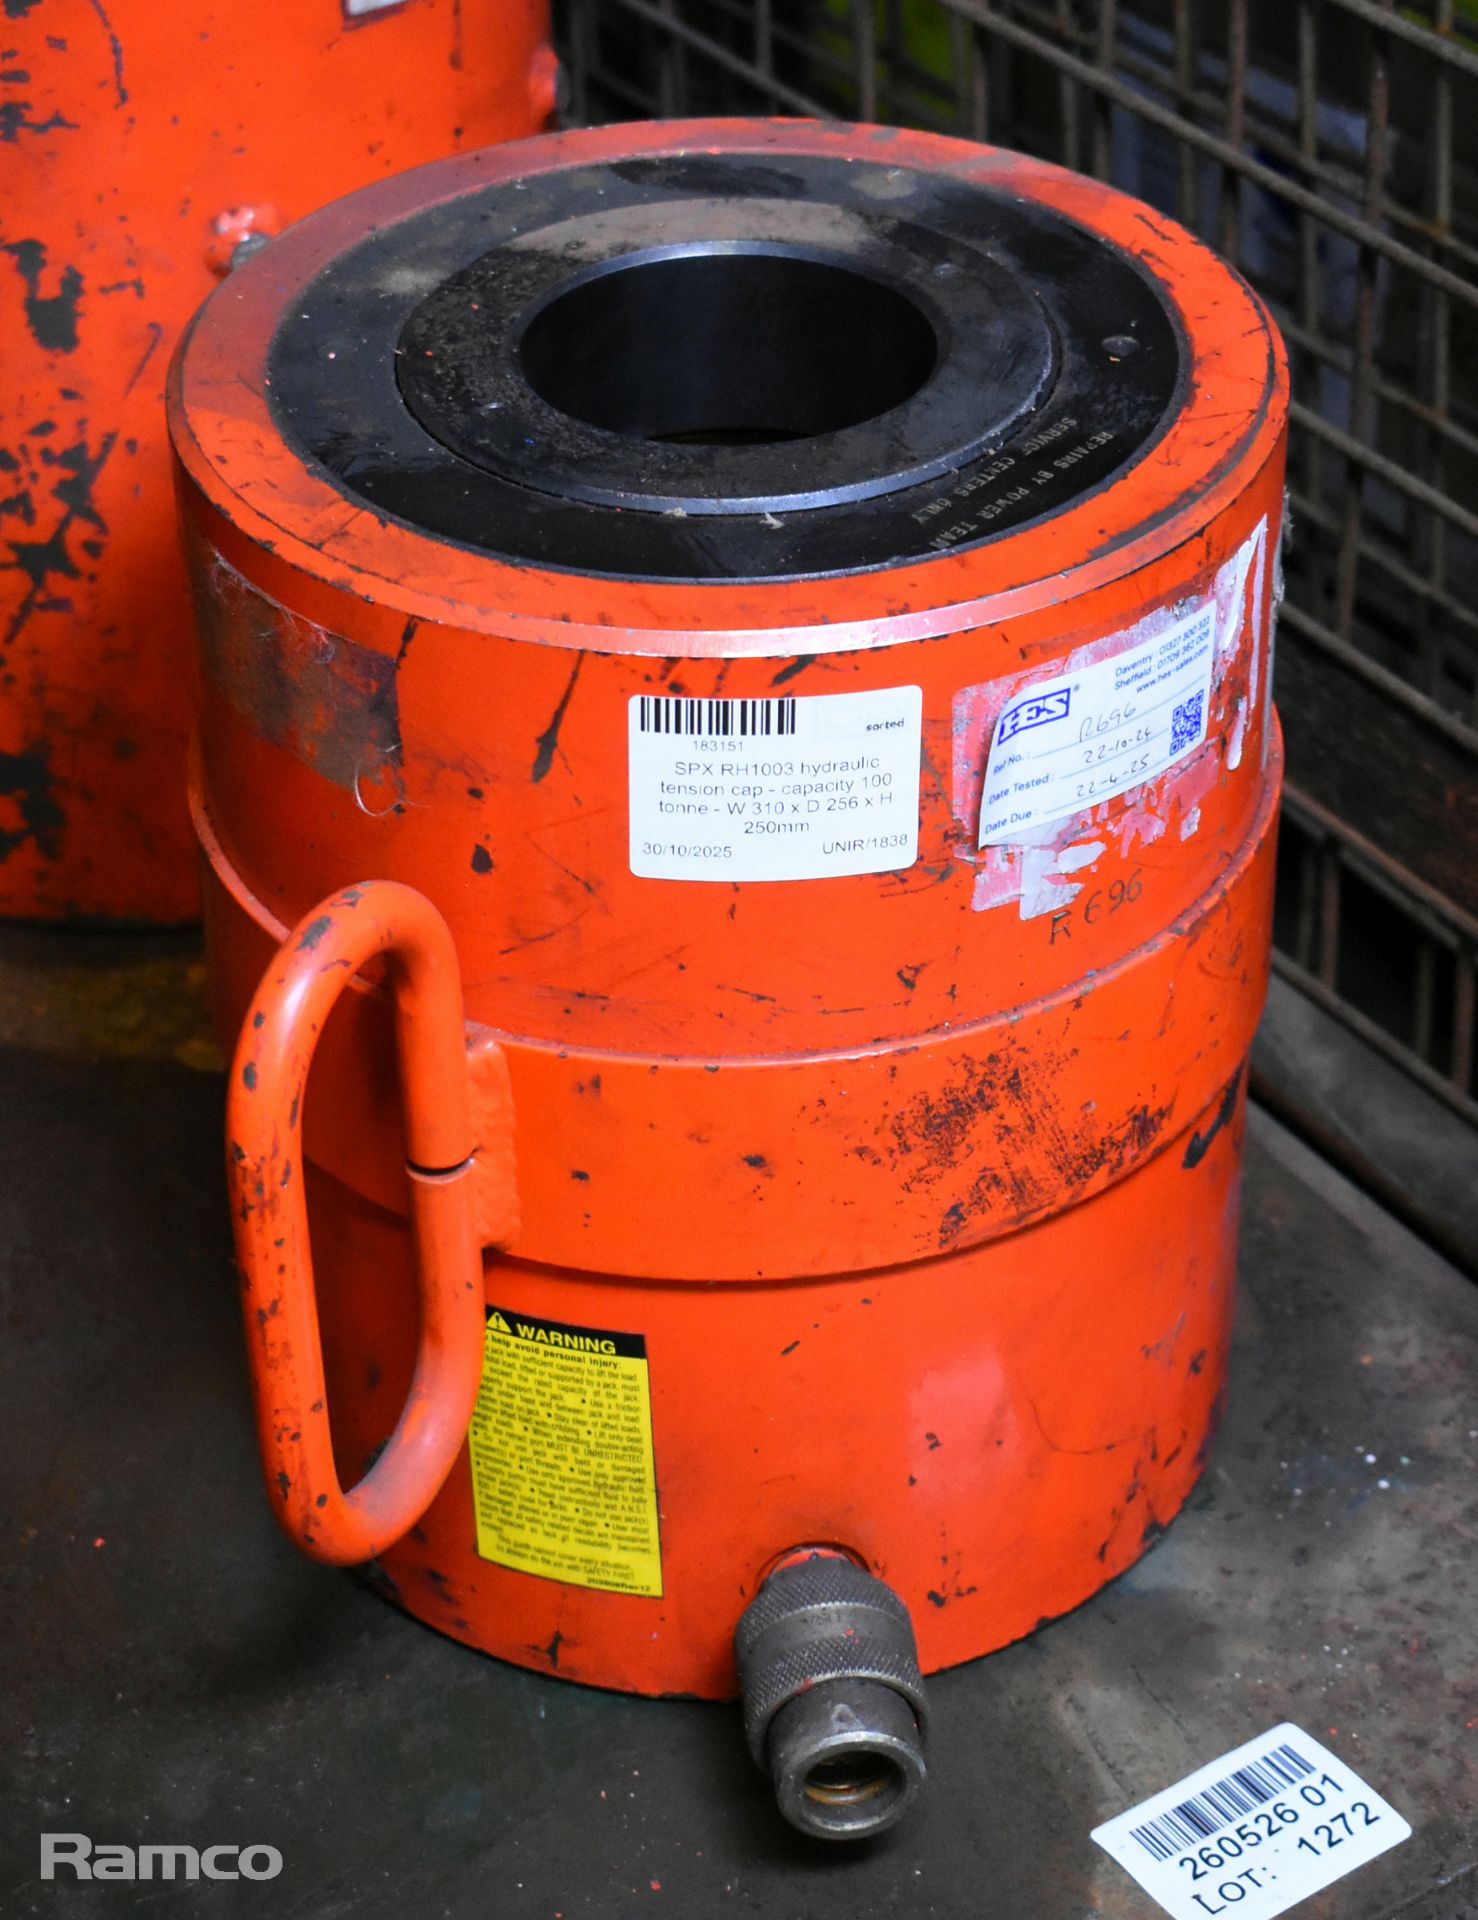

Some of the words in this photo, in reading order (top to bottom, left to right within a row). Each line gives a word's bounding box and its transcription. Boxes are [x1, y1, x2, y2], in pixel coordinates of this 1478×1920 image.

[1020, 416, 1077, 456] SERVICE
[1053, 431, 1114, 469] REPAIRS
[953, 456, 1015, 497] CENTERS
[1030, 470, 1054, 486] BY
[911, 498, 952, 523] ONLY
[975, 486, 1029, 520] POWER
[929, 520, 978, 550] TEAM
[1115, 654, 1153, 677] Daventry
[1115, 666, 1151, 689] Sheffield
[1136, 645, 1208, 693] www.hes-sales.com
[866, 718, 904, 731] sorted
[998, 688, 1070, 745] HES
[693, 740, 744, 751] 183151
[675, 762, 714, 776] SPX
[721, 762, 793, 776] RH1003
[800, 756, 880, 778] hydraulic
[993, 761, 1006, 776] Ref
[661, 781, 724, 796] tension
[731, 784, 763, 798] cap
[781, 777, 854, 794] capacity
[861, 773, 892, 788] 100
[988, 789, 1009, 805] Date
[1014, 776, 1049, 790] Tested
[659, 800, 709, 815] tonne
[727, 801, 745, 815] W
[752, 801, 785, 815] 310
[791, 803, 799, 813] x
[807, 799, 819, 813] D
[827, 797, 858, 812] 256
[864, 796, 873, 807] x
[879, 792, 892, 805] H
[744, 820, 810, 834] 250mm
[985, 818, 1007, 834] Date
[1010, 811, 1032, 822] Due
[643, 843, 732, 857] 30/10/2025
[823, 834, 908, 855] UNIR/1838
[491, 1333, 510, 1347] help
[515, 1340, 539, 1355] avoid
[543, 1348, 585, 1364] personal
[516, 1322, 616, 1355] WARNING
[1178, 1802, 1299, 1880] 260526
[1300, 1773, 1345, 1806] 01
[1191, 1865, 1277, 1915] LOT:
[1297, 1802, 1380, 1858] 1272
